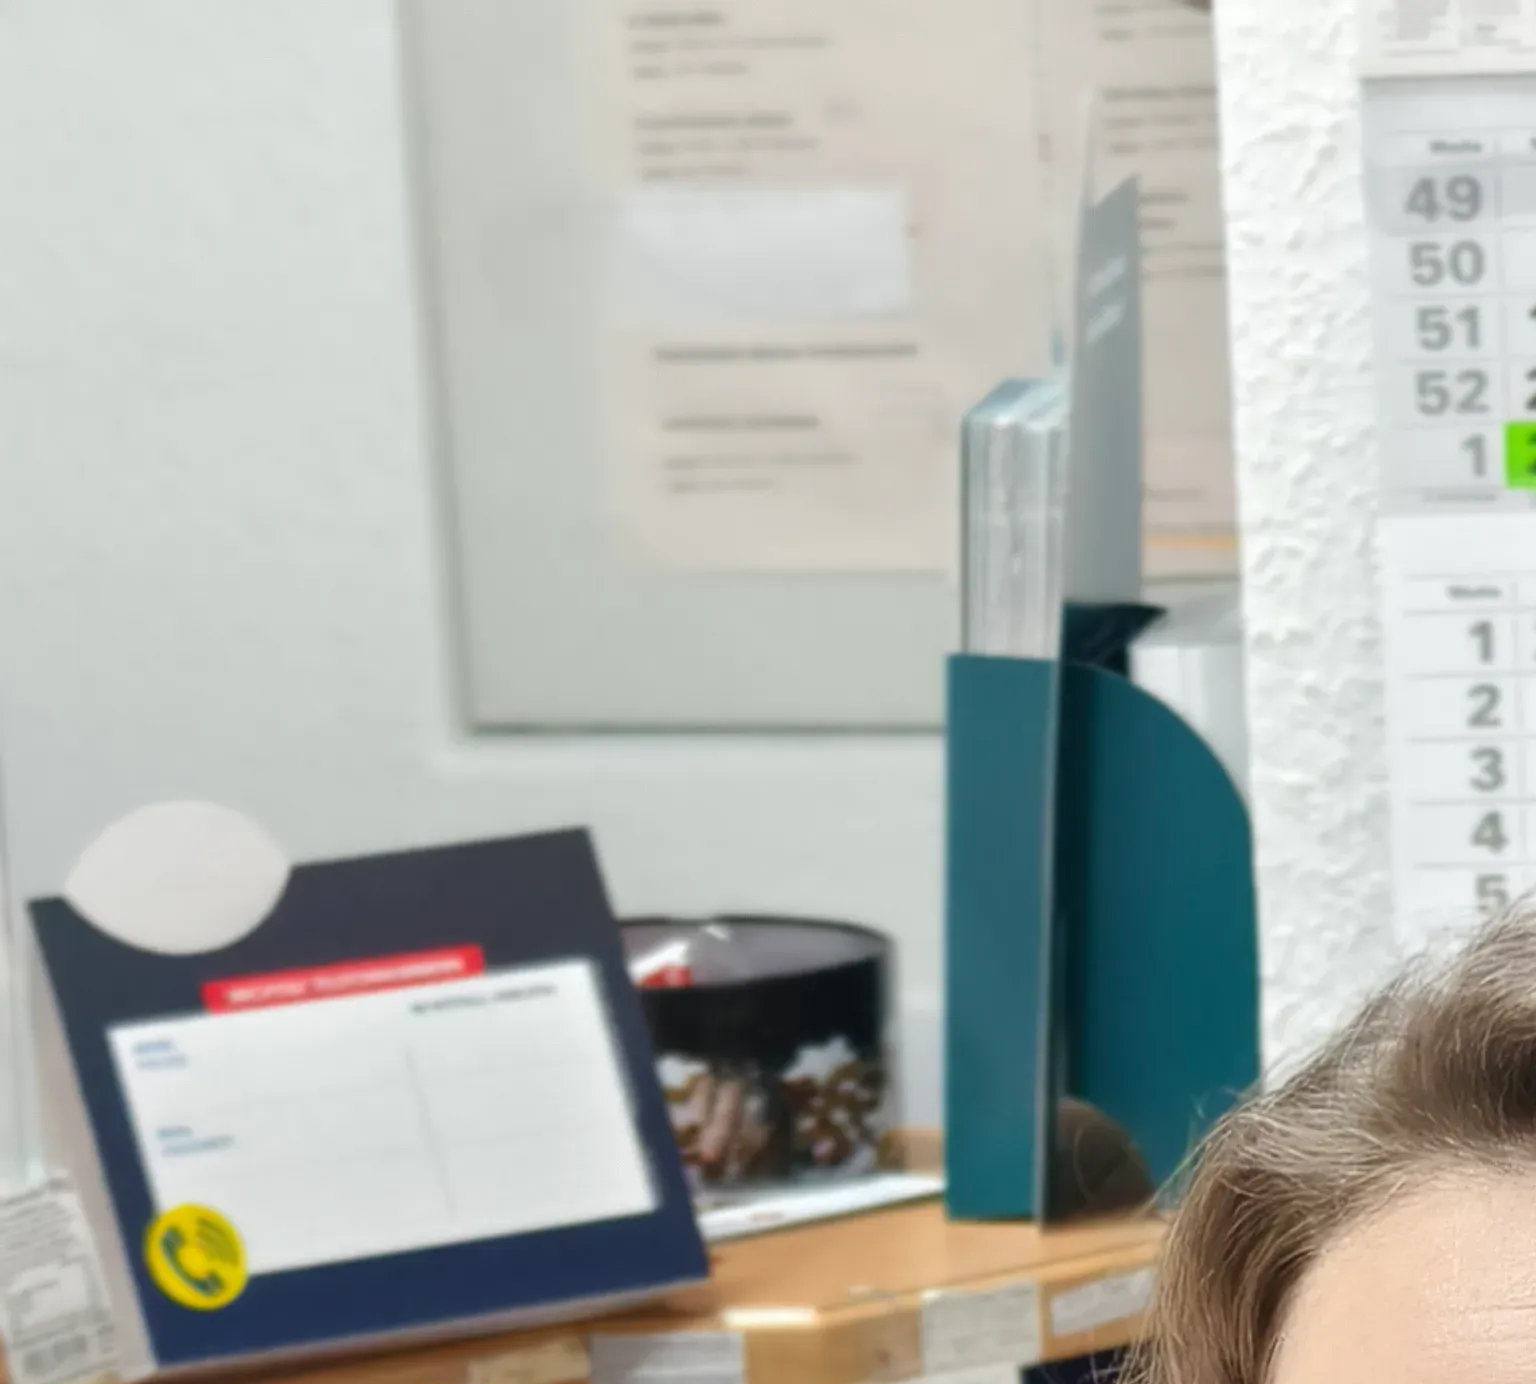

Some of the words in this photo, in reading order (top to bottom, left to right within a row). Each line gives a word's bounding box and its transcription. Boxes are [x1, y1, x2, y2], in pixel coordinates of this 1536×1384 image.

[1404, 174, 1483, 222] 49
[1409, 239, 1485, 287] 50
[1416, 305, 1481, 351] 51
[1416, 369, 1490, 416] 52
[1460, 433, 1485, 478] 1
[1469, 620, 1493, 664] 1
[1468, 683, 1502, 728] 2
[1470, 746, 1505, 792] 3
[1470, 810, 1508, 854] 4
[1476, 872, 1509, 912] 5
